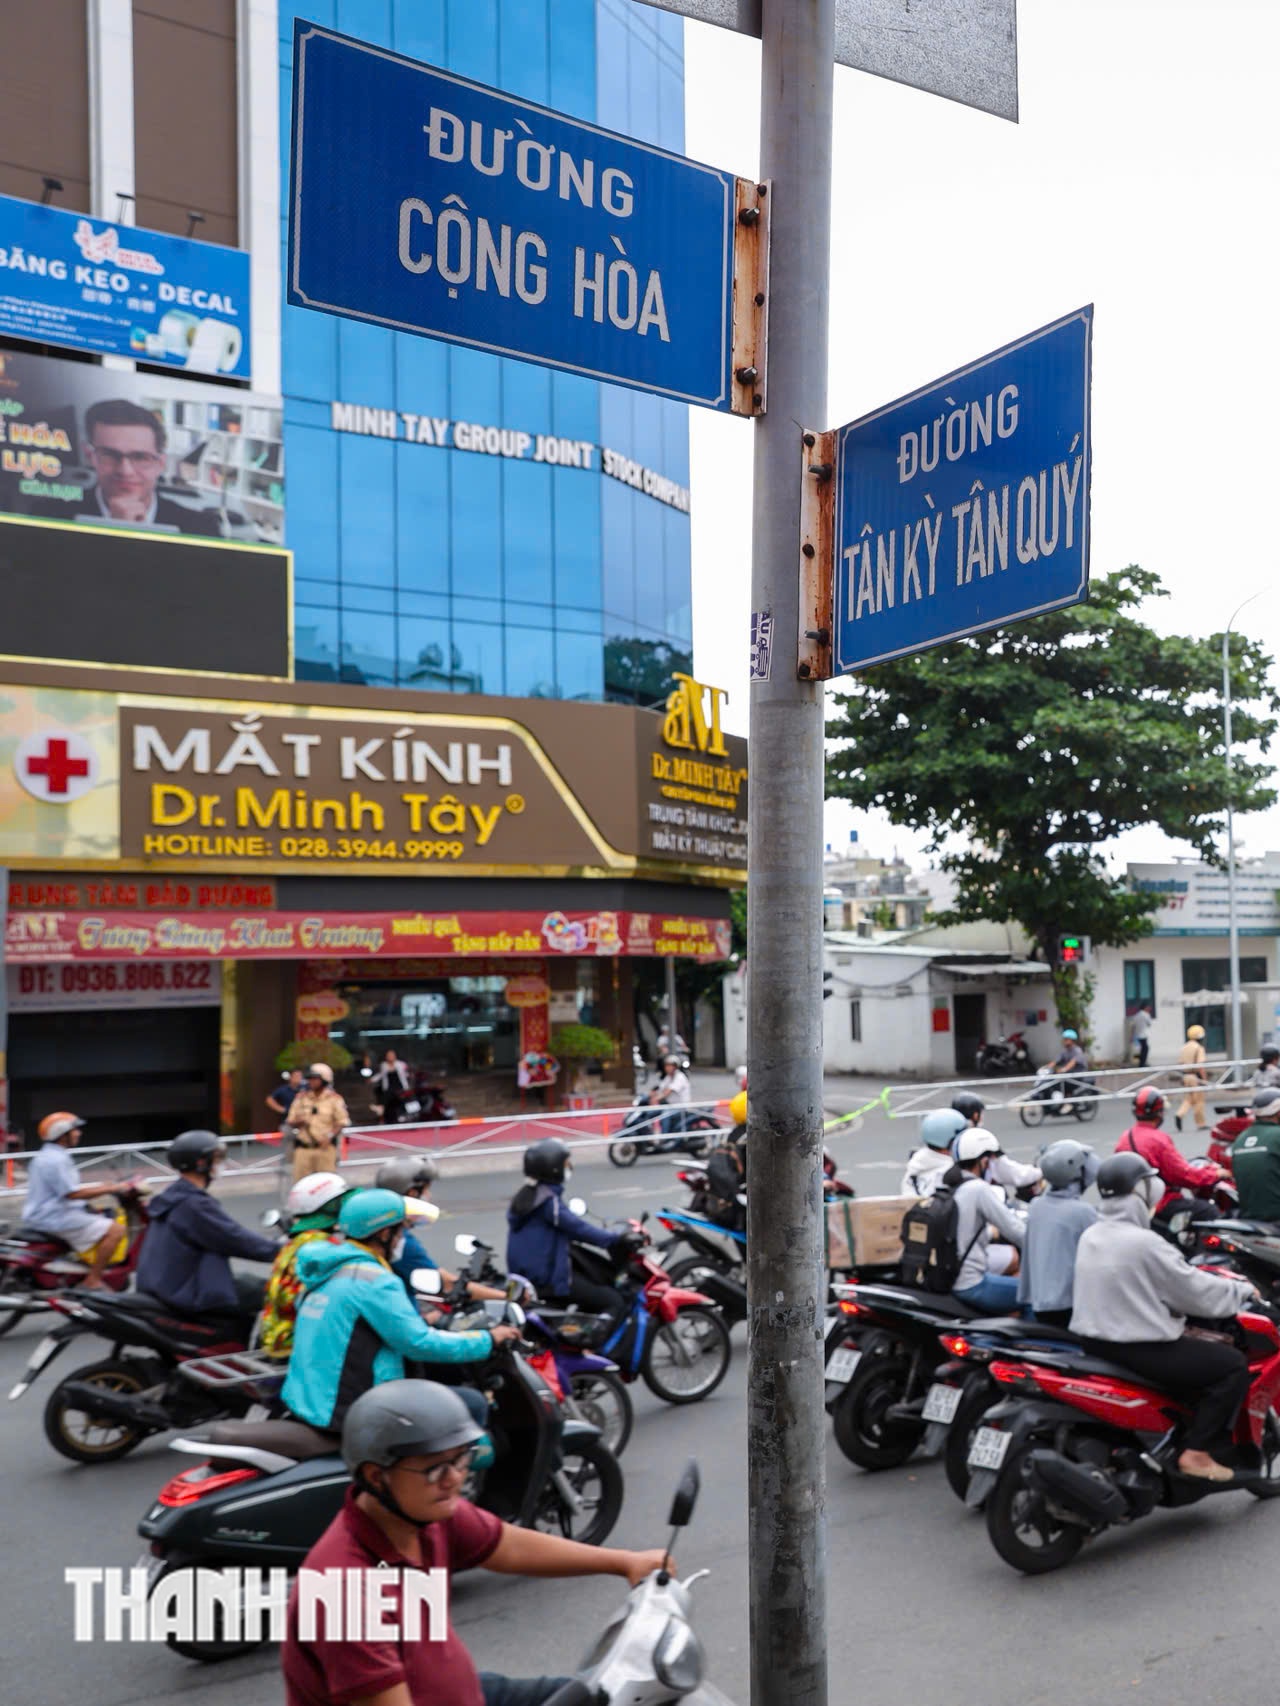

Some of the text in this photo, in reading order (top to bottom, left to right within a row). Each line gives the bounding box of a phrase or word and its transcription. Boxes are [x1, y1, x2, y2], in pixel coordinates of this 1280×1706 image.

[423, 106, 635, 218] ĐƯỜNG
[74, 265, 130, 293] KEO
[158, 281, 238, 316] DECAL
[398, 193, 671, 343] CỘNG HÒA
[331, 401, 397, 439] MINH
[402, 414, 450, 447] TAY
[453, 422, 532, 459] GROUP
[533, 435, 594, 470] JOINT
[602, 449, 642, 492] STOCK
[896, 384, 1019, 484] ĐƯỜNG
[843, 431, 1083, 622] TÂN KỲ TÂN QUÝ
[132, 711, 512, 786] MẮT KÍNH
[144, 834, 465, 859] HOTLINE: 028.3944.9999
[8, 882, 80, 905] RUNG
[61, 961, 211, 993] 0936.806.622
